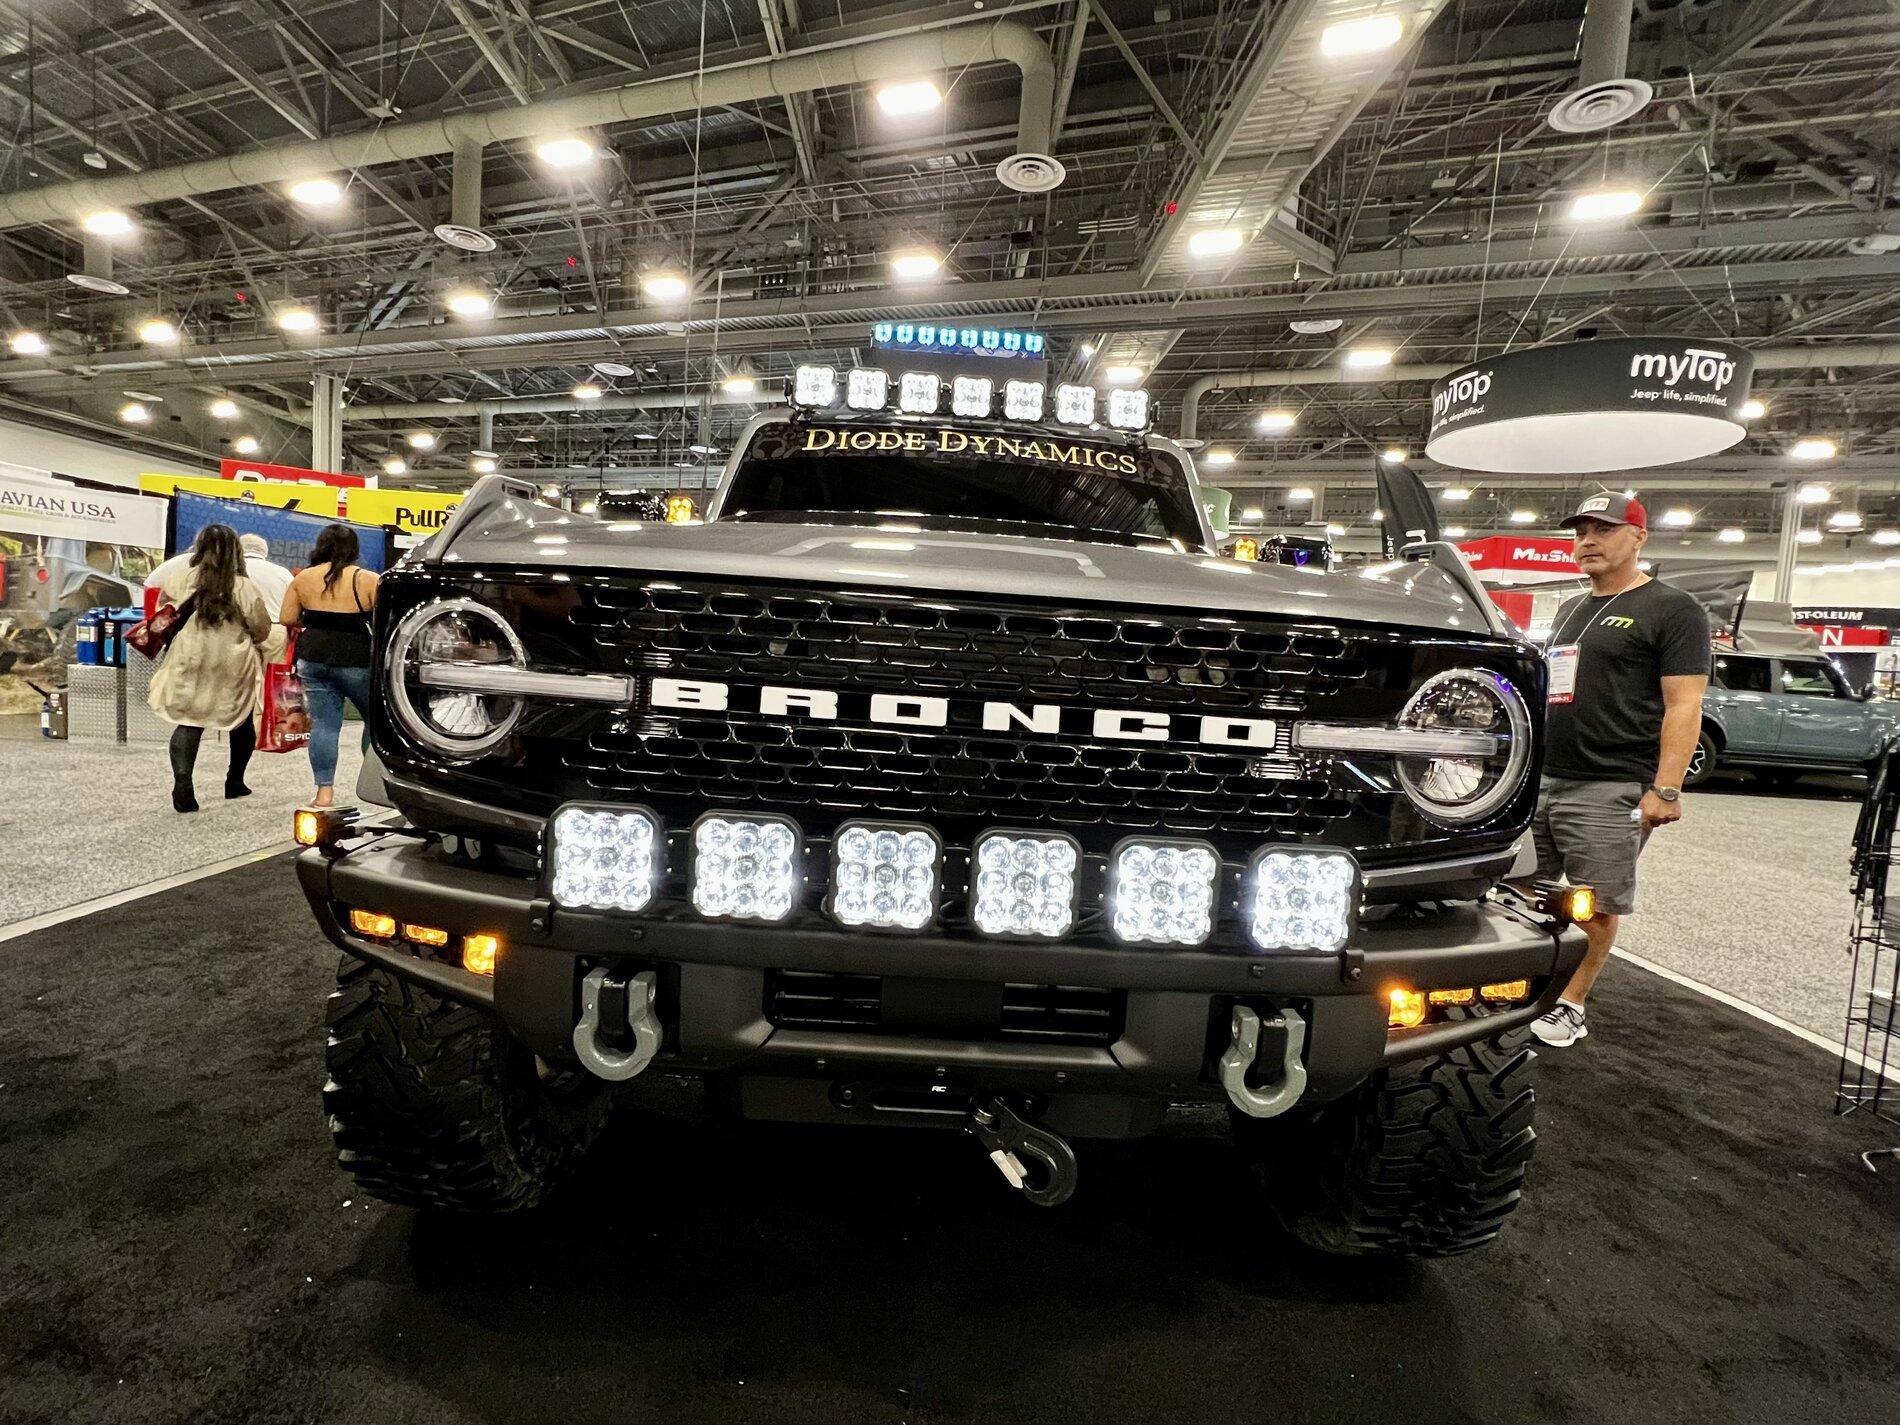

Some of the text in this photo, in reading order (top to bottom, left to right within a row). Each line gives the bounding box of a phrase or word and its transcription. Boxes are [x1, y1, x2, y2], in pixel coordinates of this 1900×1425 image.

[1630, 348, 1734, 391] myTop
[1433, 371, 1492, 416] myTop
[1630, 388, 1728, 407] Jeep life, simplified.
[802, 429, 1138, 475] DIODE DYNAMICS
[70, 501, 116, 519] USA
[650, 677, 1277, 750] BRONCO
